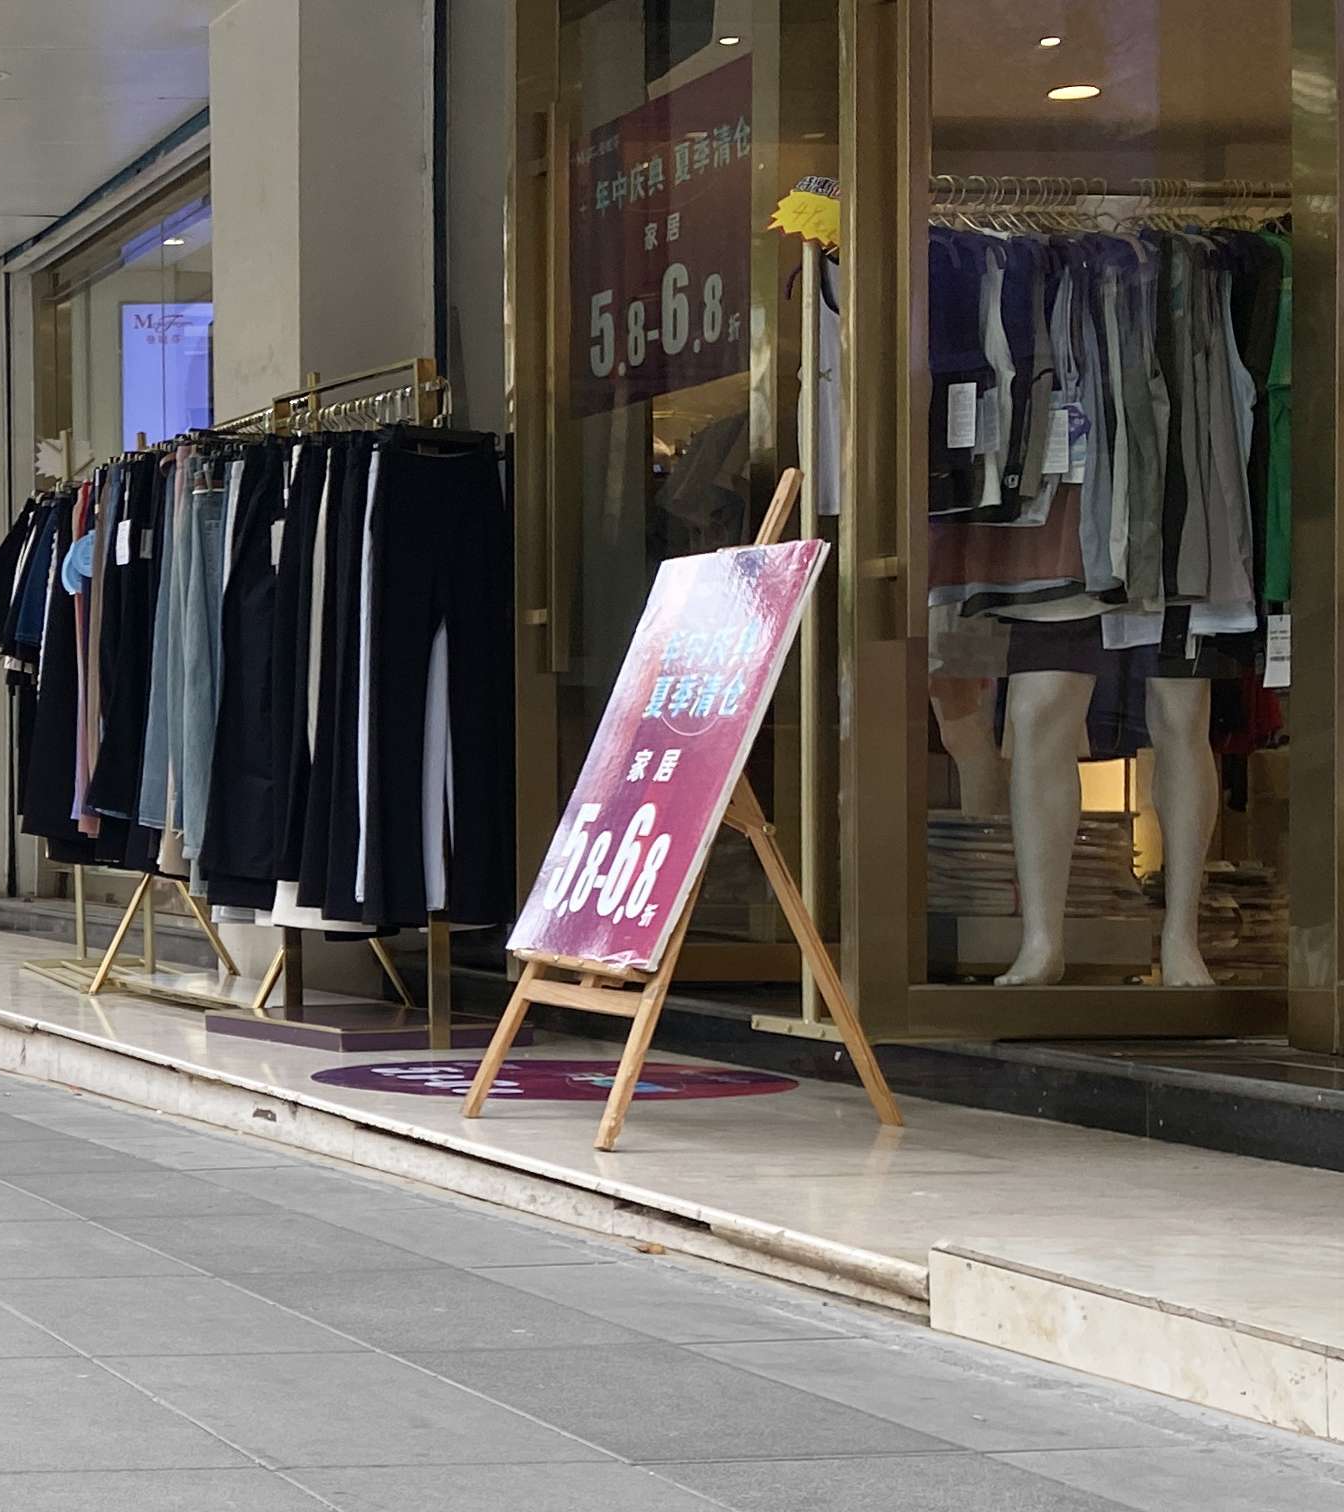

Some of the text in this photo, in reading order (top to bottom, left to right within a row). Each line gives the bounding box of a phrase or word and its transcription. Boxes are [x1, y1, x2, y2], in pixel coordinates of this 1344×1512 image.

[595, 155, 665, 215] 年中庆典
[674, 116, 750, 185] 夏季清仓
[644, 213, 680, 250] 家居
[643, 667, 746, 718] 夏季清仓
[626, 749, 682, 782] 家居
